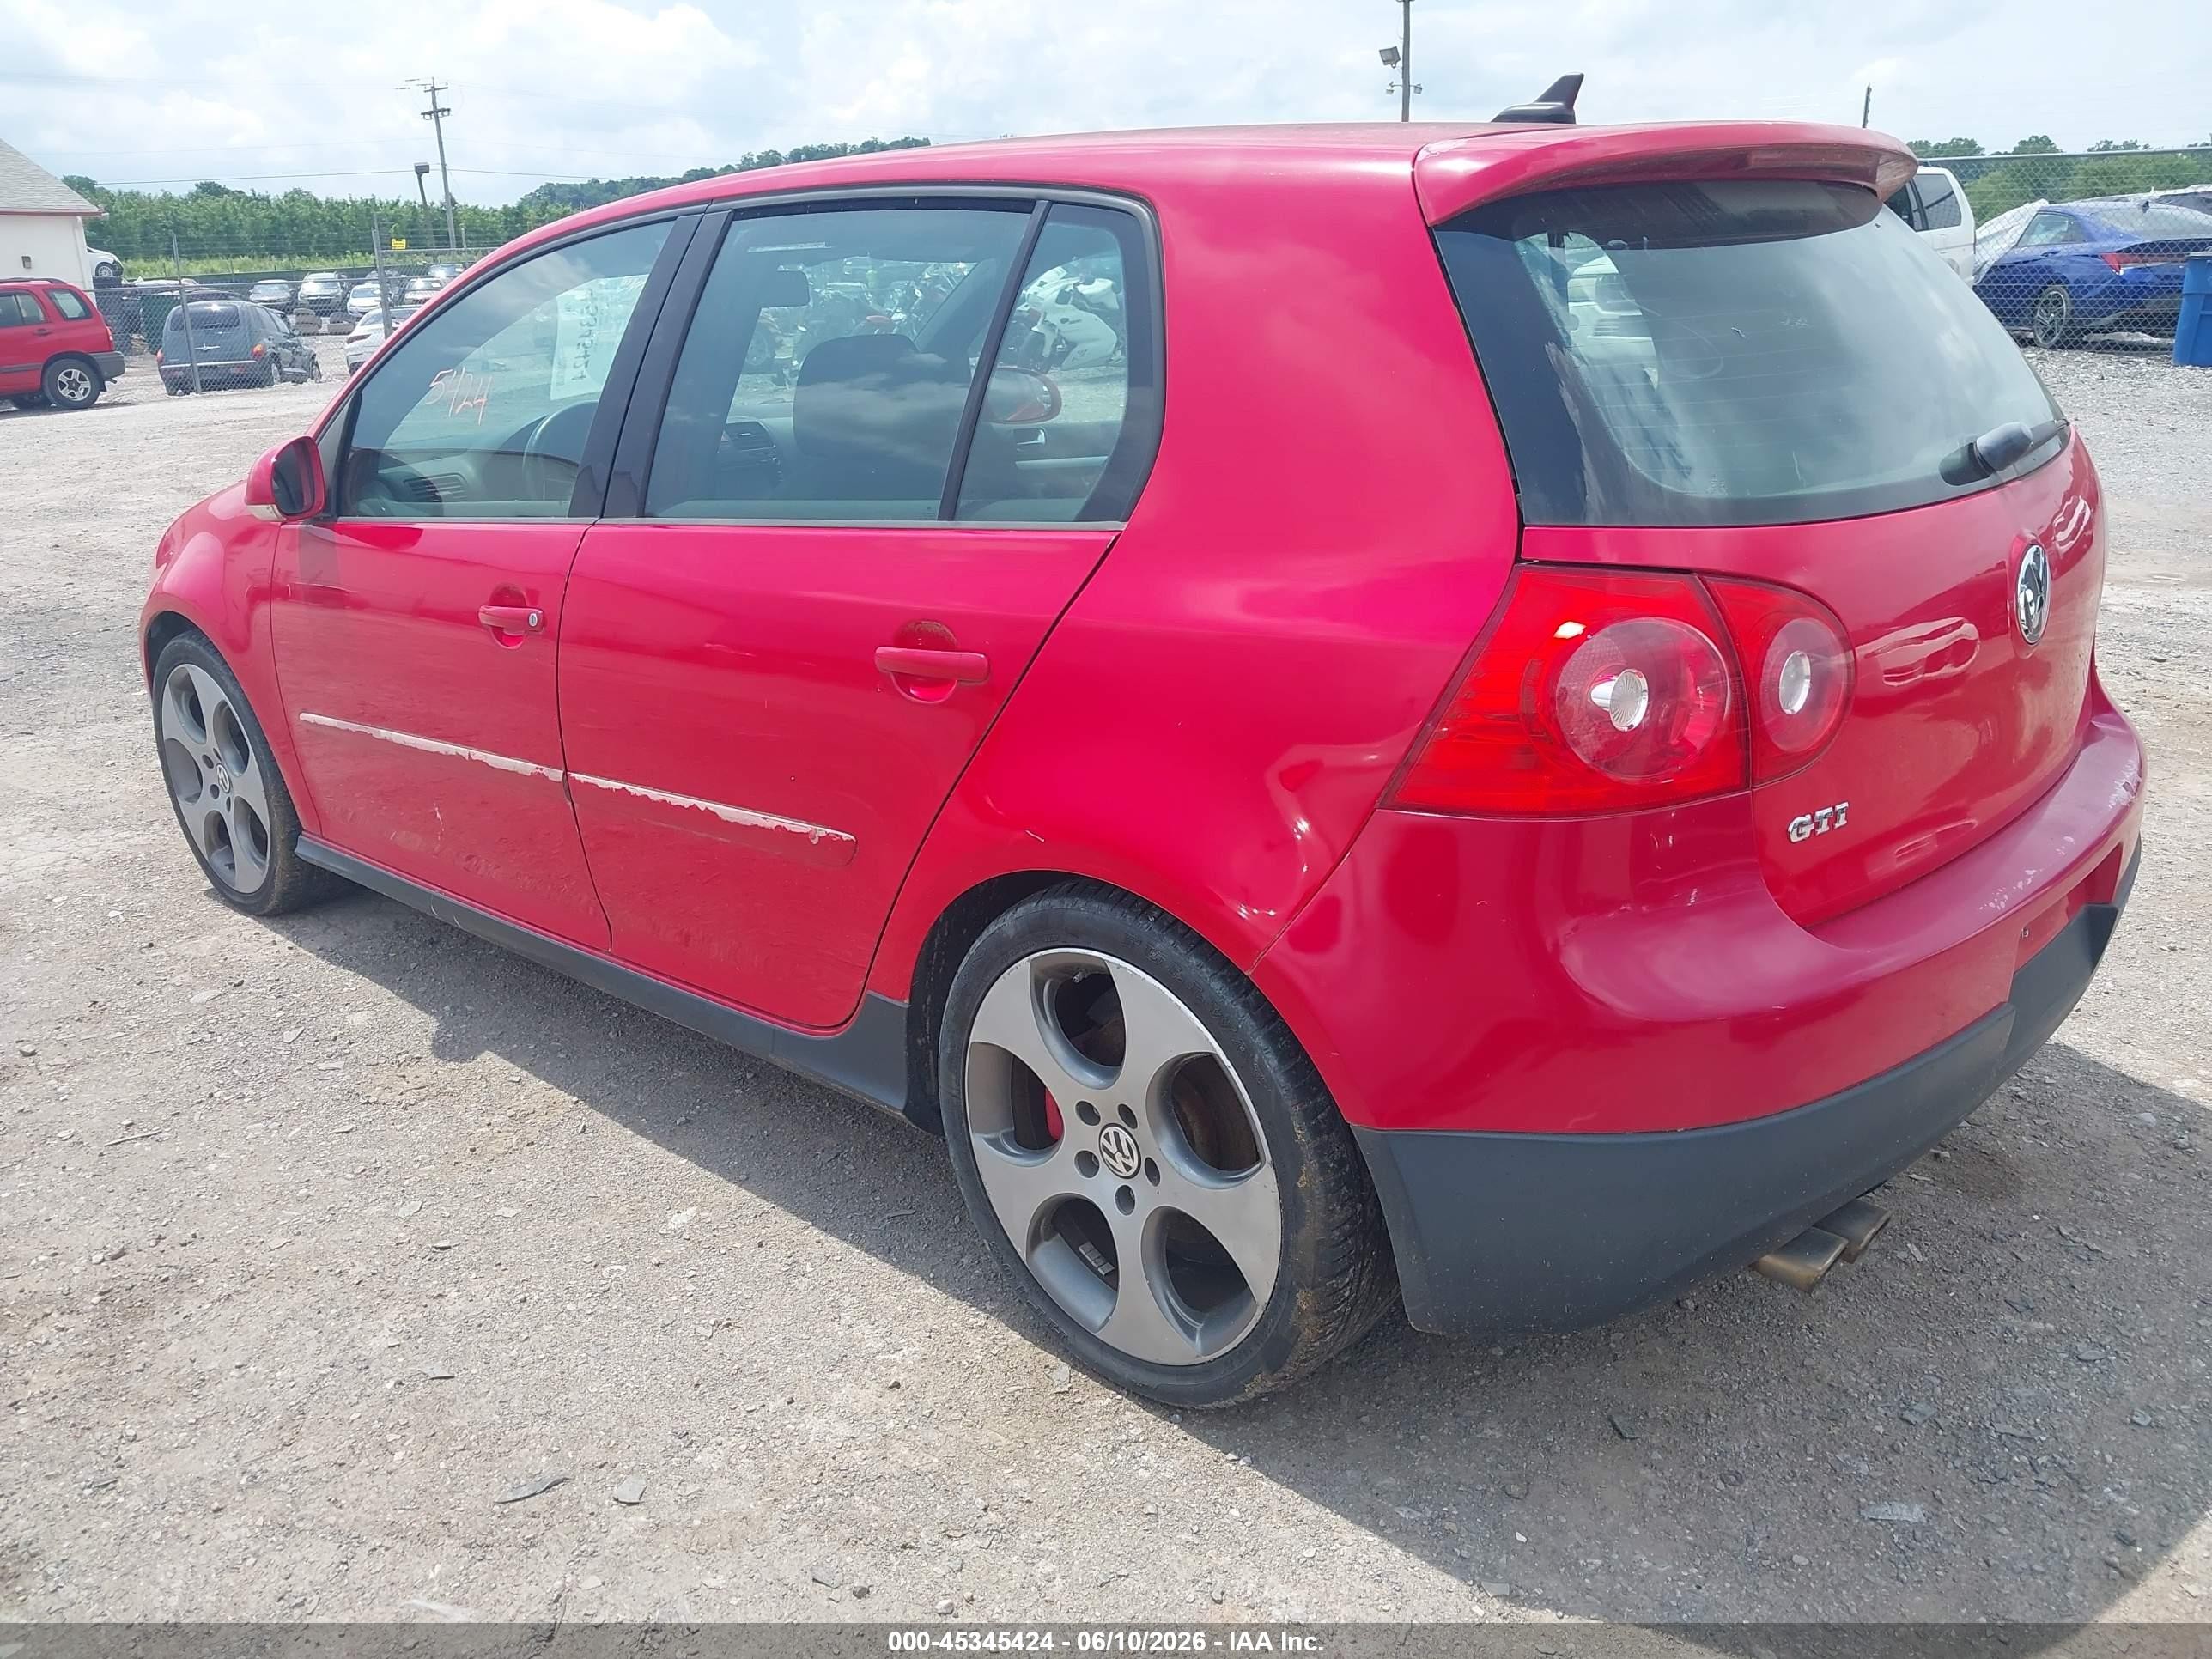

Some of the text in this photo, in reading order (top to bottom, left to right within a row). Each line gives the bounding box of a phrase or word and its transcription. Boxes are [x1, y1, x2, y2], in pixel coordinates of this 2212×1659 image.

[425, 366, 494, 426] 5424
[1787, 801, 1850, 844] GTI
[1099, 1123, 1141, 1179] VW
